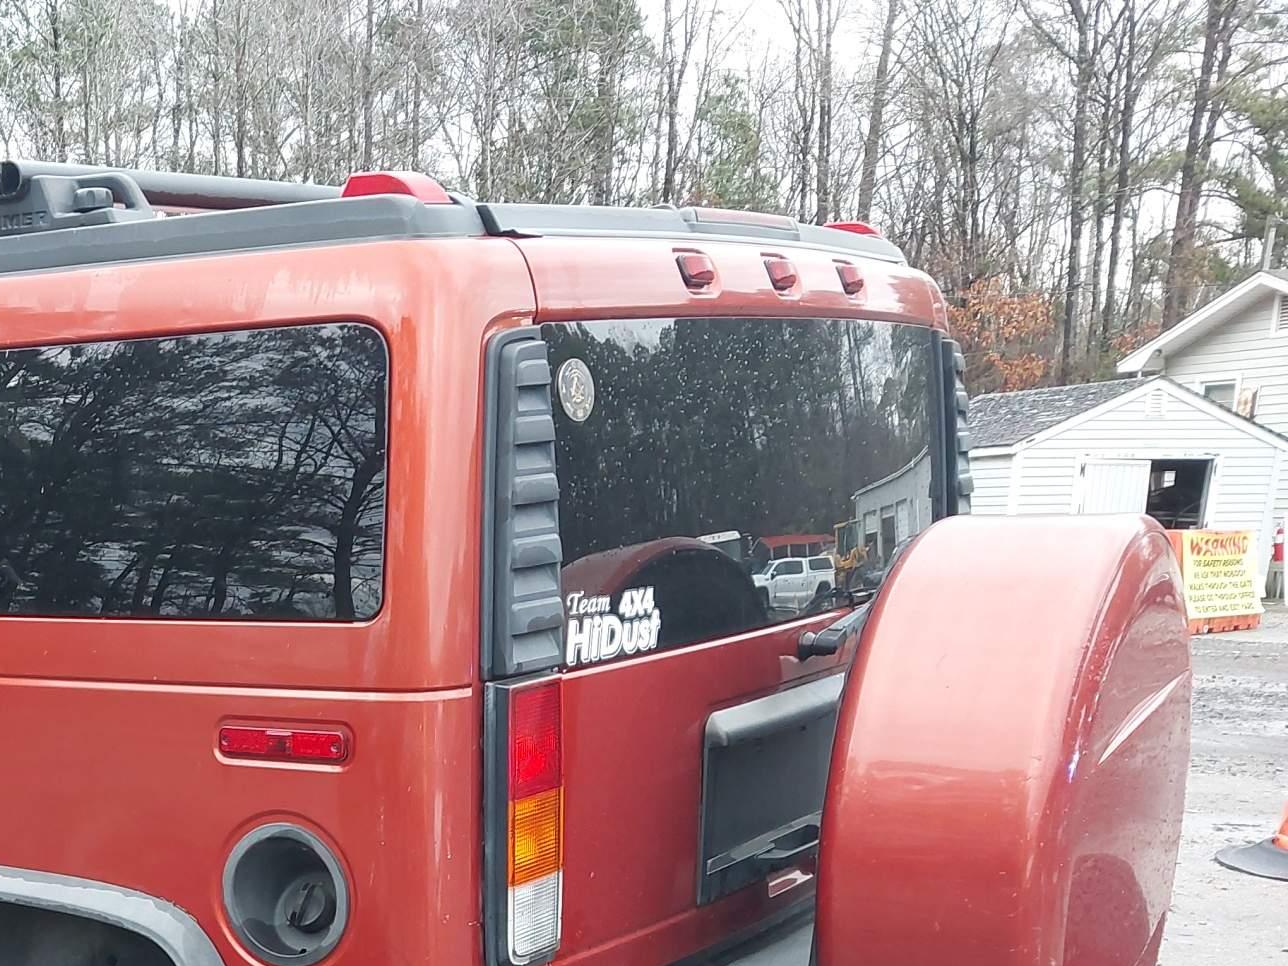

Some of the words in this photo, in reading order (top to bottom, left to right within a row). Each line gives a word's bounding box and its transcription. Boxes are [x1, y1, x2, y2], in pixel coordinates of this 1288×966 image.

[1190, 536, 1248, 556] WARNING
[1203, 559, 1222, 567] SAFETY
[567, 591, 611, 615] Team
[619, 586, 655, 617] 4X4
[566, 608, 661, 665] HiDust
